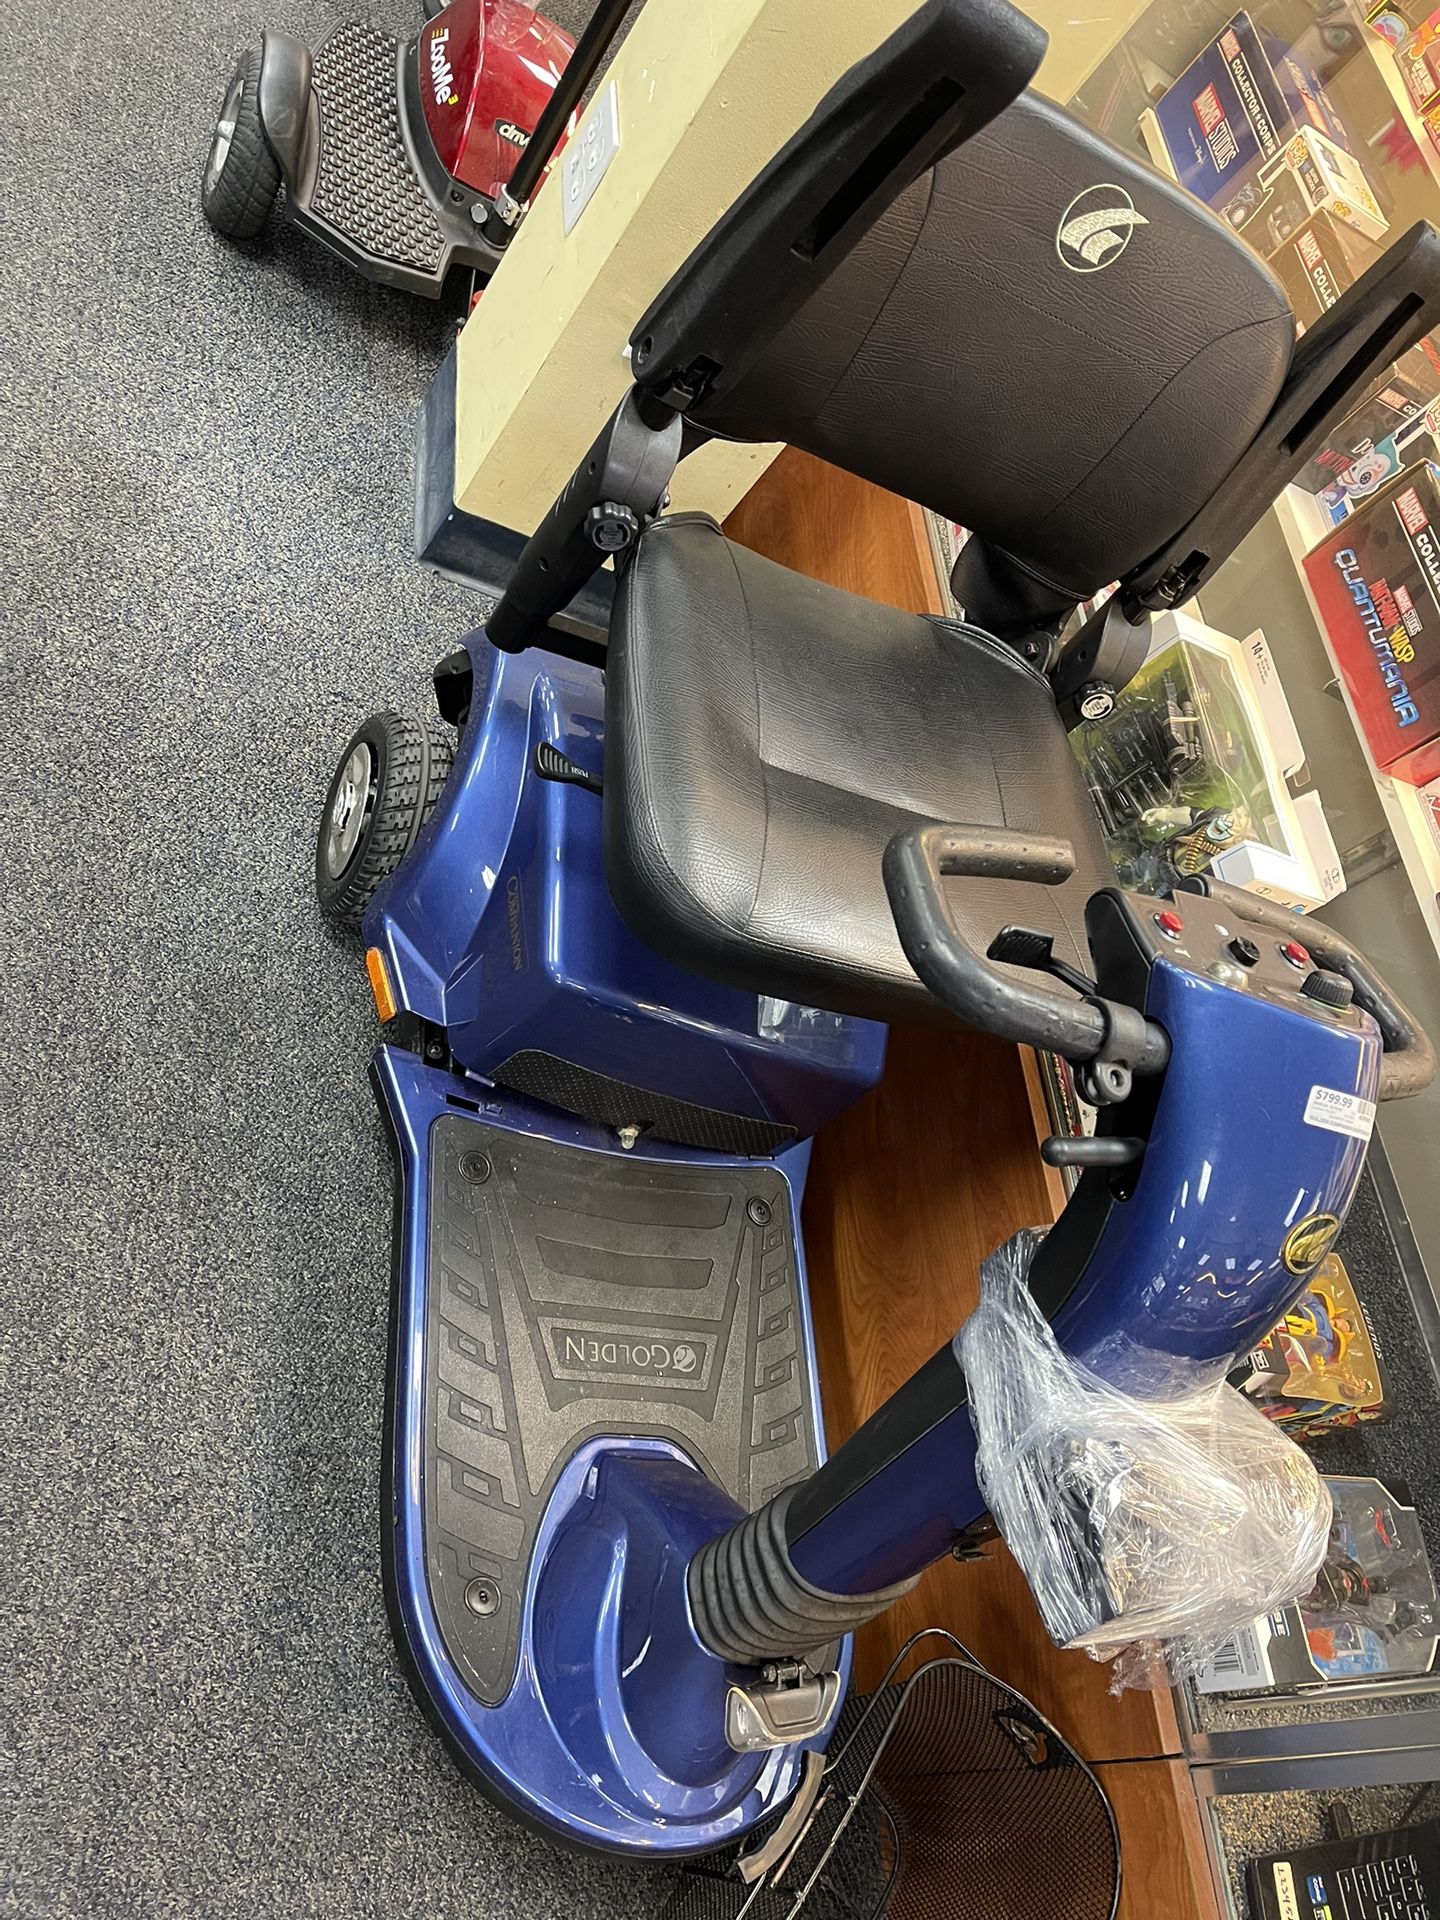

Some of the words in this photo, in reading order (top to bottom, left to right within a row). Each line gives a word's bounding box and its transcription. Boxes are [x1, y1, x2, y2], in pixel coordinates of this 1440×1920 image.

[499, 123, 530, 146] driv
[1193, 84, 1224, 136] MARVEL
[1209, 121, 1237, 170] STUDIOS
[1232, 58, 1260, 115] COLLECTOR
[1256, 119, 1276, 155] CORPS
[1297, 229, 1323, 271] MARVEL
[1313, 266, 1337, 309] COLLE
[1395, 486, 1429, 536] MARVEL
[1416, 533, 1440, 593] COLLE
[1334, 548, 1420, 728] QUANTUMANIA
[1389, 625, 1415, 664] WASP
[1402, 608, 1422, 636] STUDIOS
[1315, 1089, 1353, 1108] $799.99
[566, 1336, 671, 1368] GOLDEN
